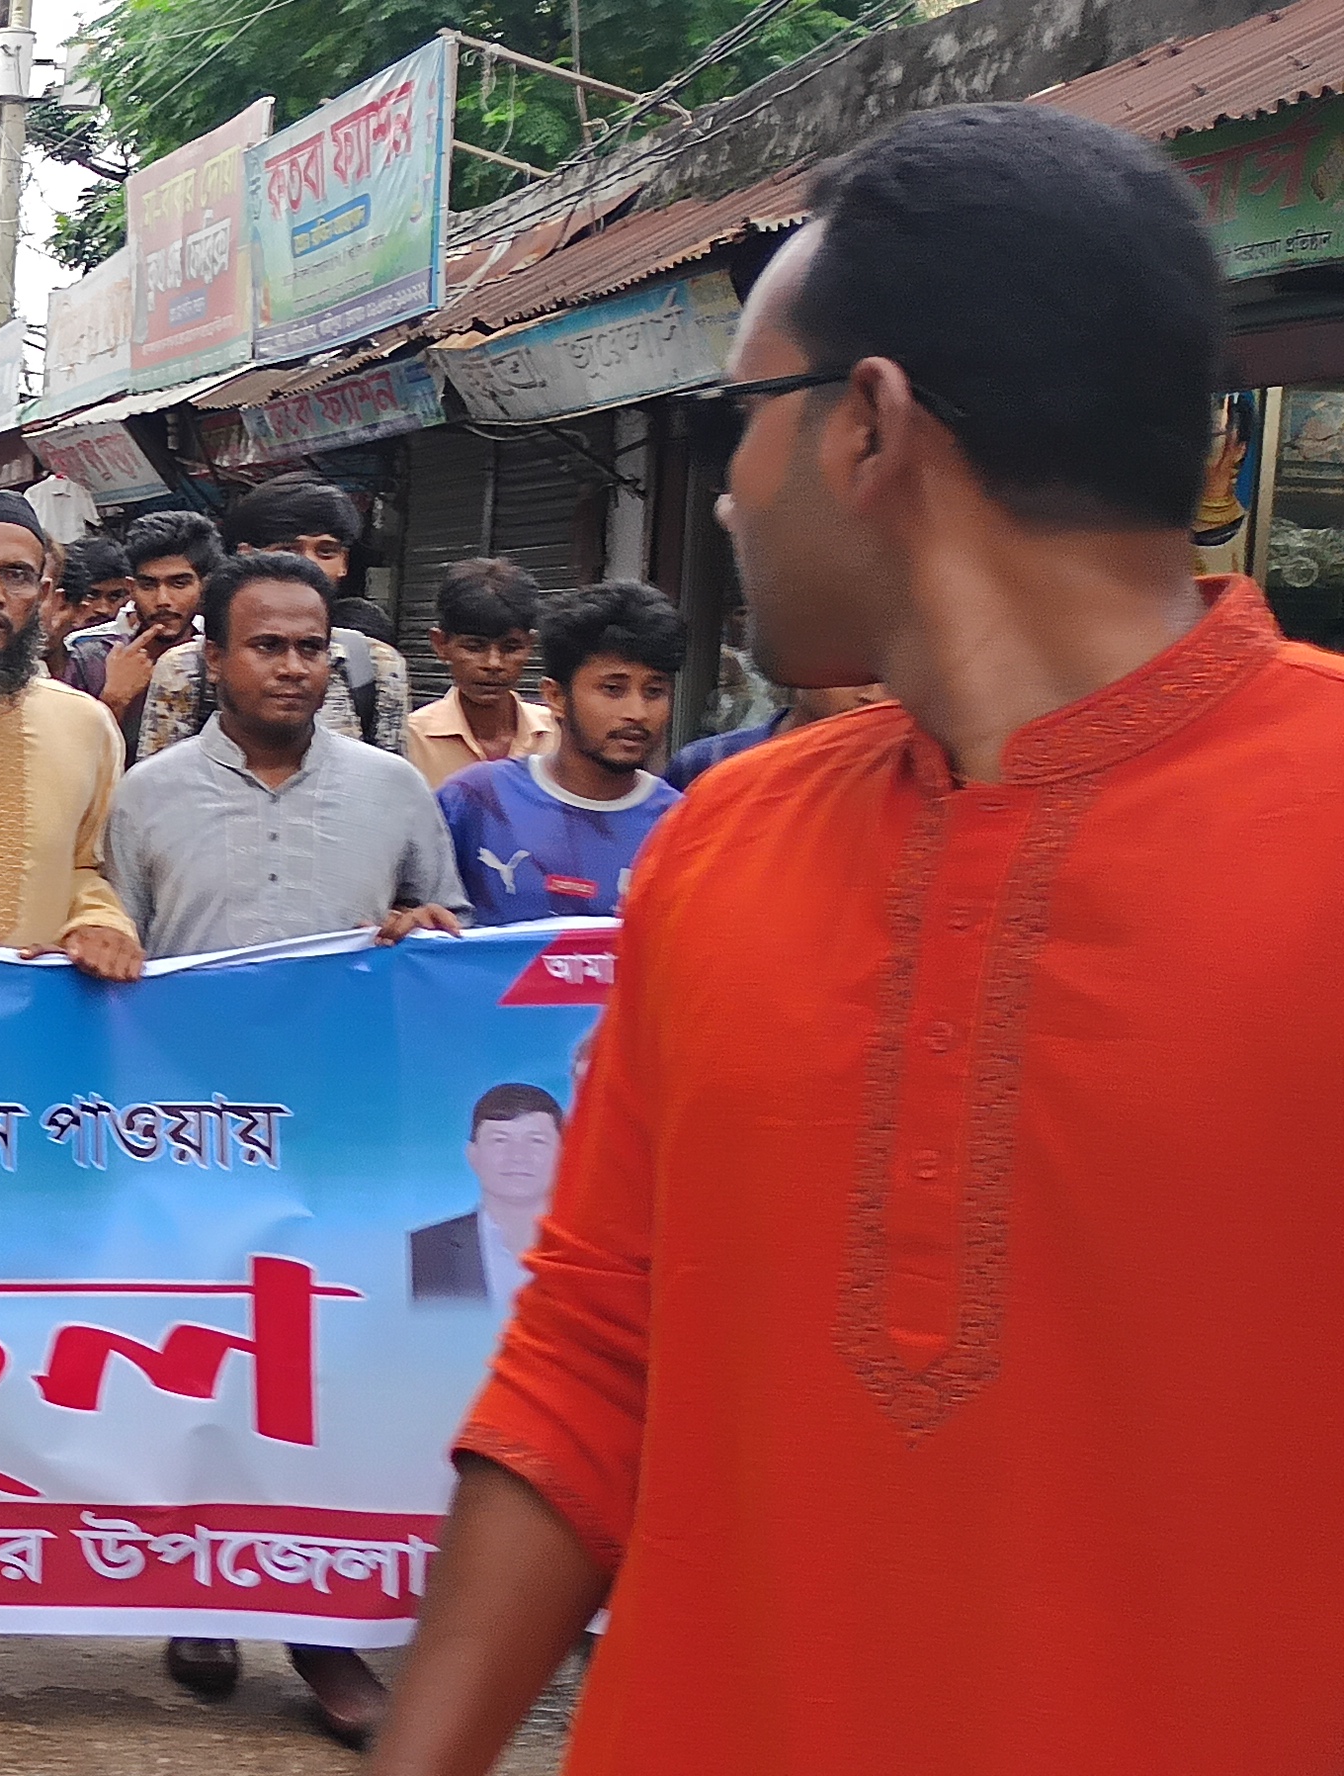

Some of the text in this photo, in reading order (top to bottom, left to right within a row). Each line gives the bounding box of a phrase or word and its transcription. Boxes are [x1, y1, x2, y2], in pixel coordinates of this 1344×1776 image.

[330, 79, 416, 189] ফ্যাশন
[41, 1091, 293, 1171] পাওয়ায়
[72, 1510, 442, 1600] উপজেলা
